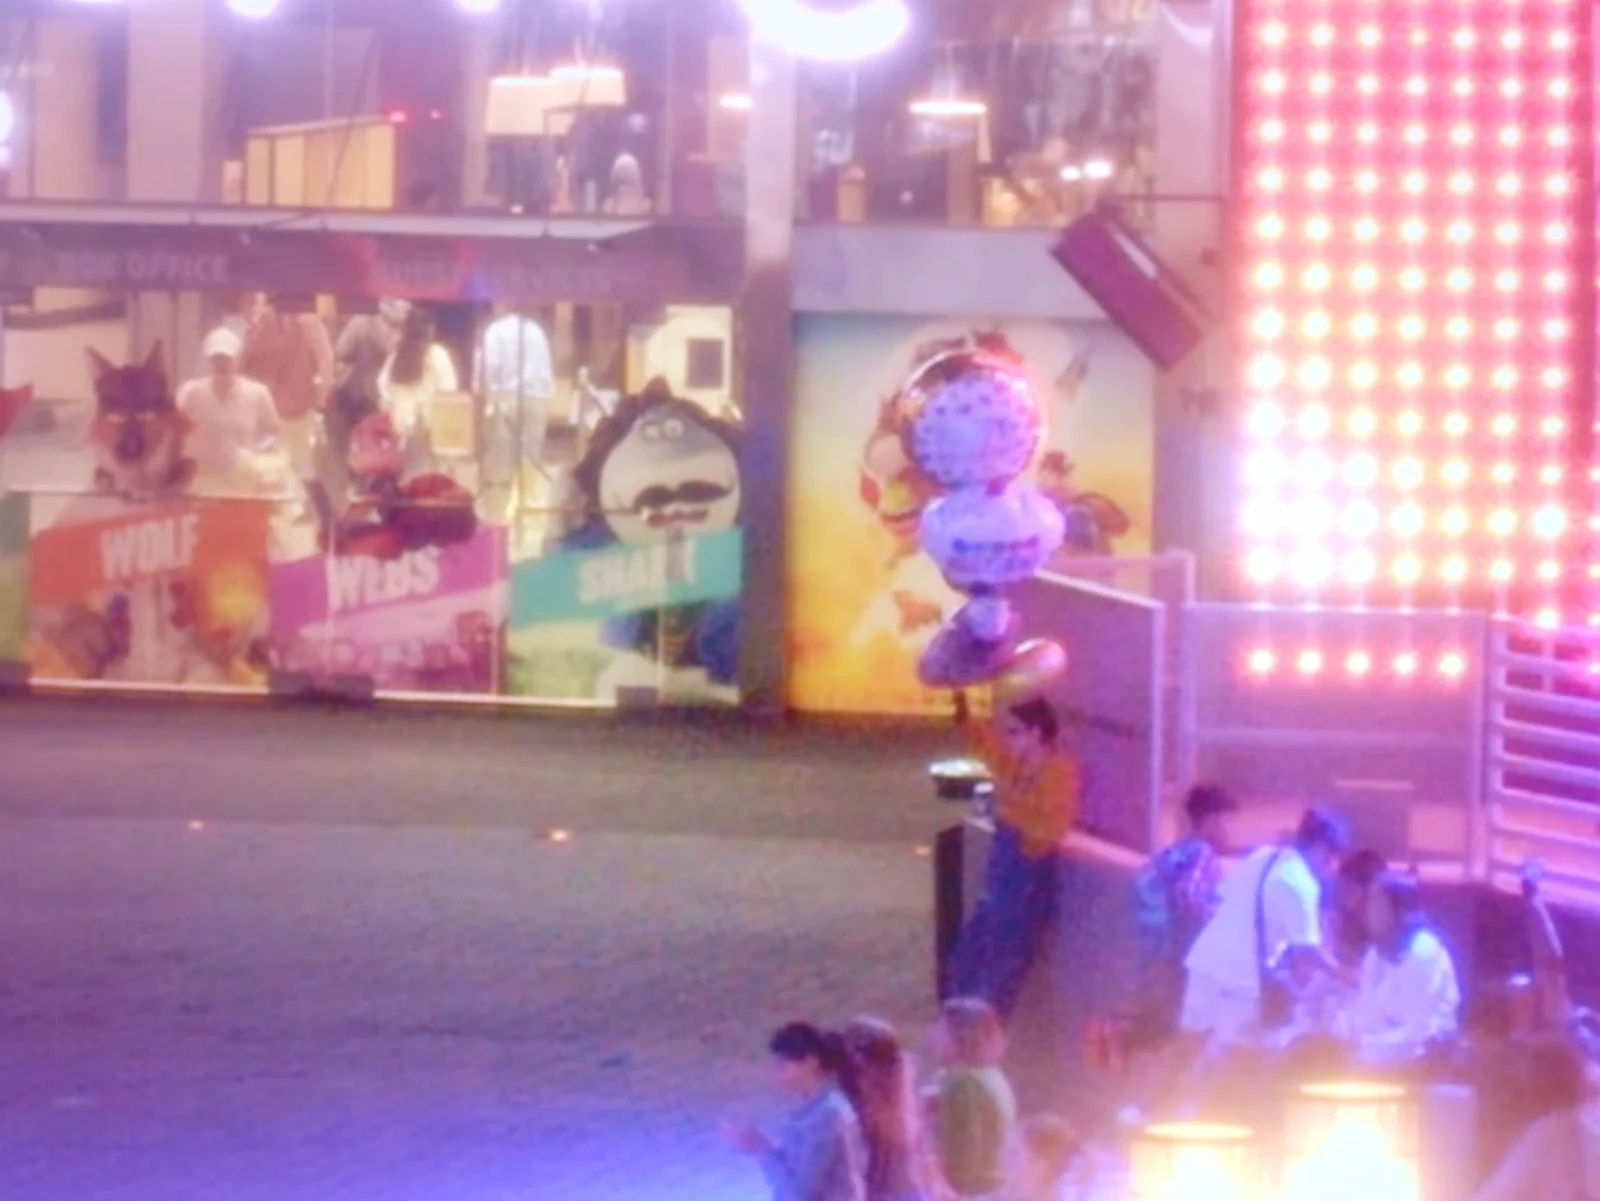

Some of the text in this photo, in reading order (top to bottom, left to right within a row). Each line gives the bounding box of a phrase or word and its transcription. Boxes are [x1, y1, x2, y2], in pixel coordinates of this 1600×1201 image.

[57, 252, 230, 283] BOX OFFICE
[101, 513, 199, 580] WOLF
[326, 545, 441, 609] WEBS
